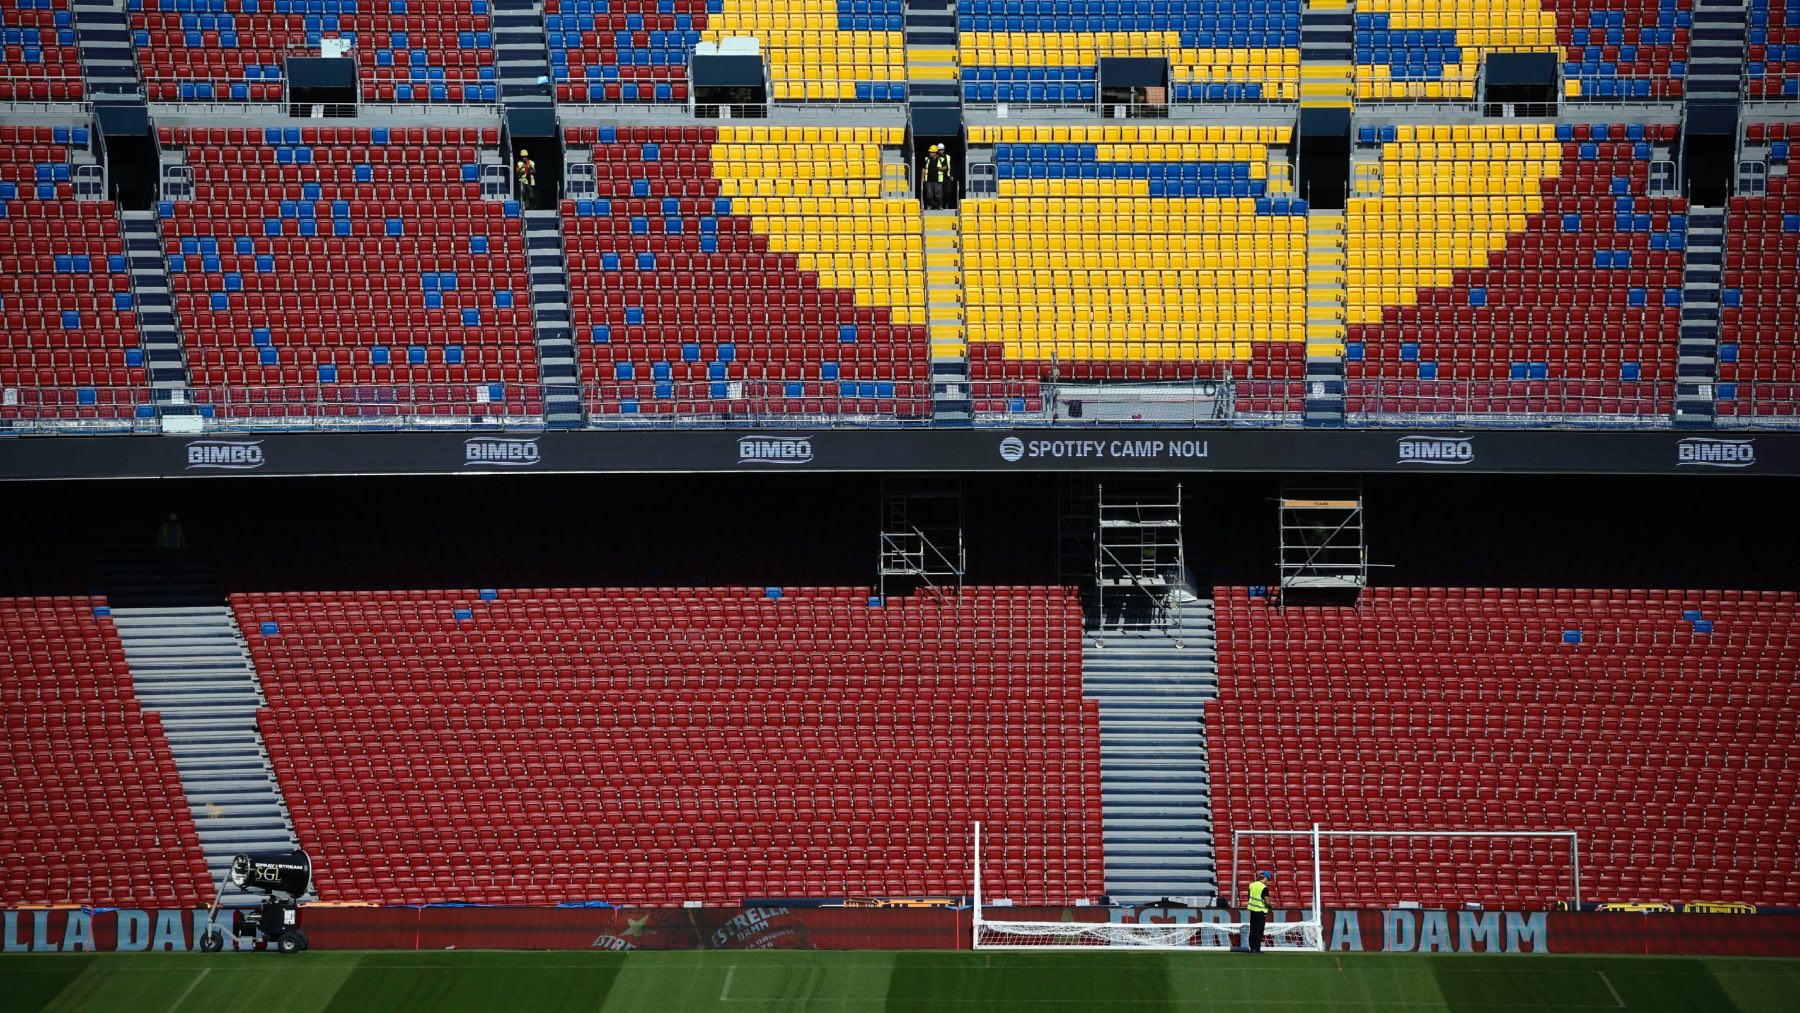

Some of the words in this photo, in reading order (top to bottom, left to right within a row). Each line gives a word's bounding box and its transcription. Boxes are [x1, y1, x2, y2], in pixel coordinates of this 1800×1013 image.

[188, 446, 262, 463] BIMBO
[466, 443, 538, 460] BIMBO
[739, 441, 811, 458] BIMBO
[1028, 440, 1106, 457] SPOTIFY
[1110, 440, 1165, 457] CAMP
[1169, 440, 1208, 457] NOU
[1399, 441, 1472, 459] BIMBO
[1679, 443, 1753, 461] BIMBO
[255, 866, 282, 881] SGL
[2, 909, 97, 952] LLA
[1381, 910, 1550, 953] DAMM
